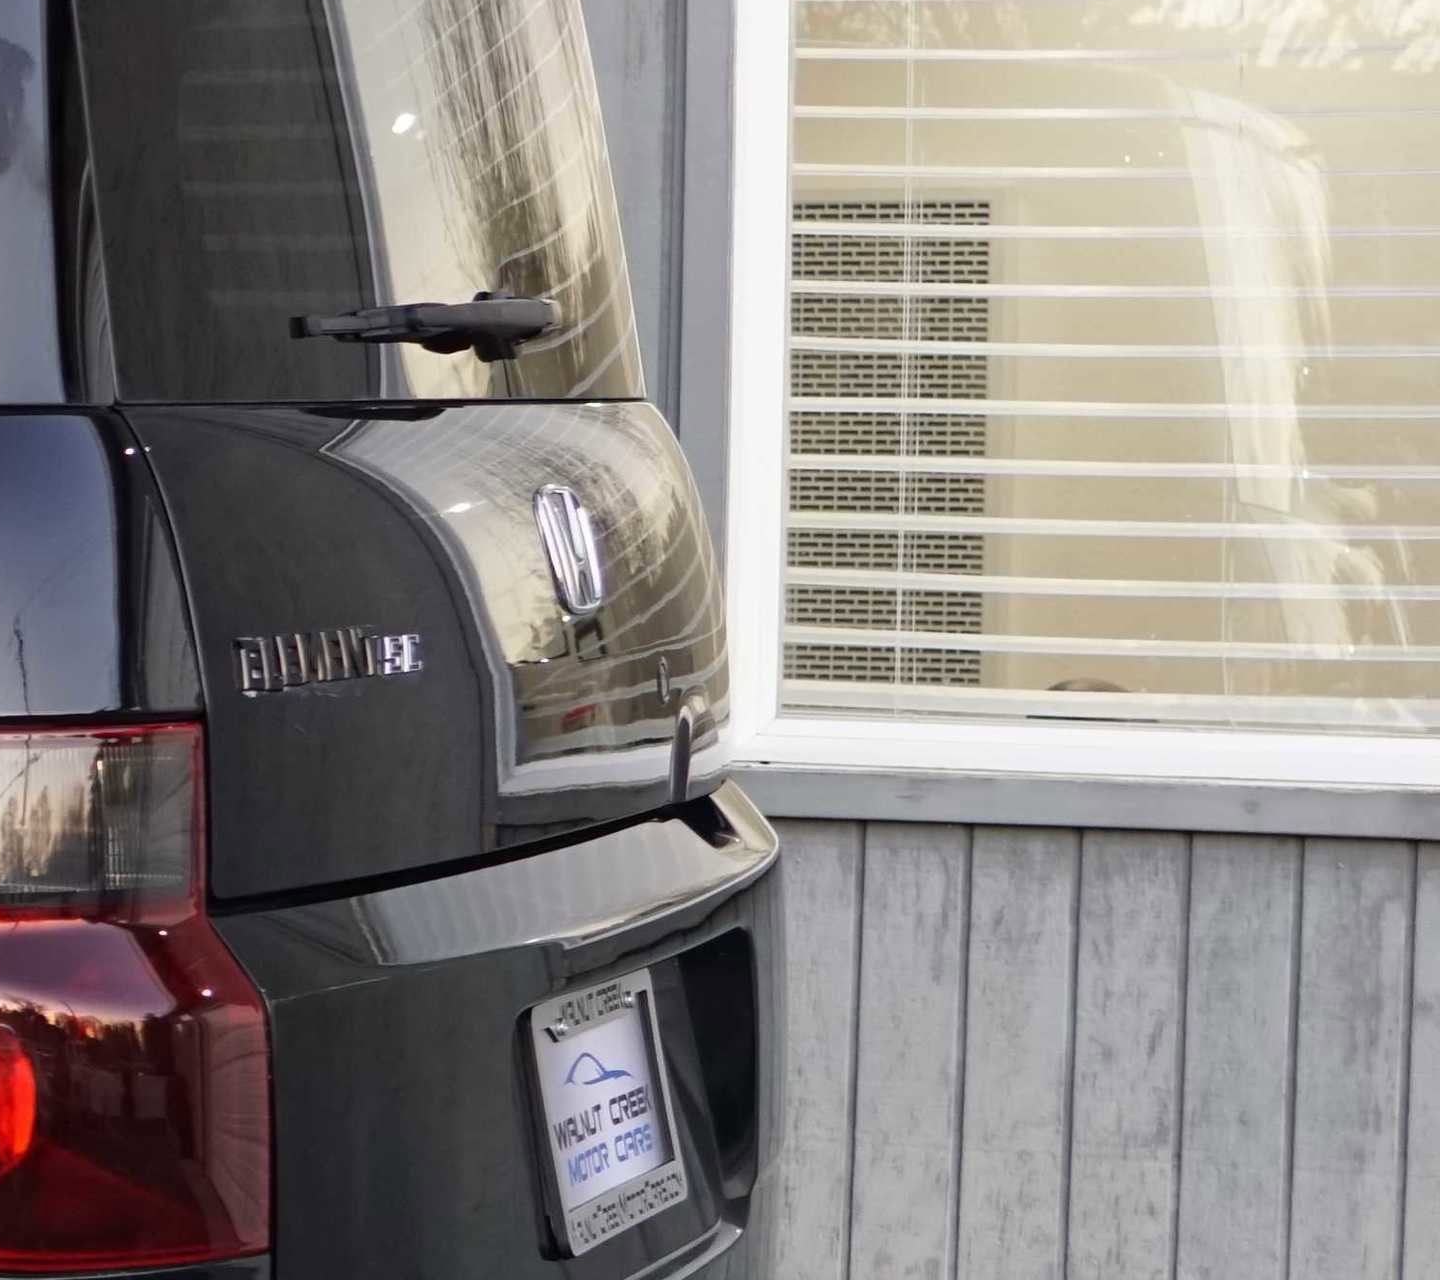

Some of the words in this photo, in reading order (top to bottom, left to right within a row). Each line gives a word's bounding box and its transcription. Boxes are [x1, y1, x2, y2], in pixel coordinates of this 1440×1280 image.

[552, 1103, 603, 1151] WALNUT
[609, 1084, 652, 1126] CREEK
[567, 1142, 610, 1187] MOTOR
[614, 1124, 653, 1162] CARS
